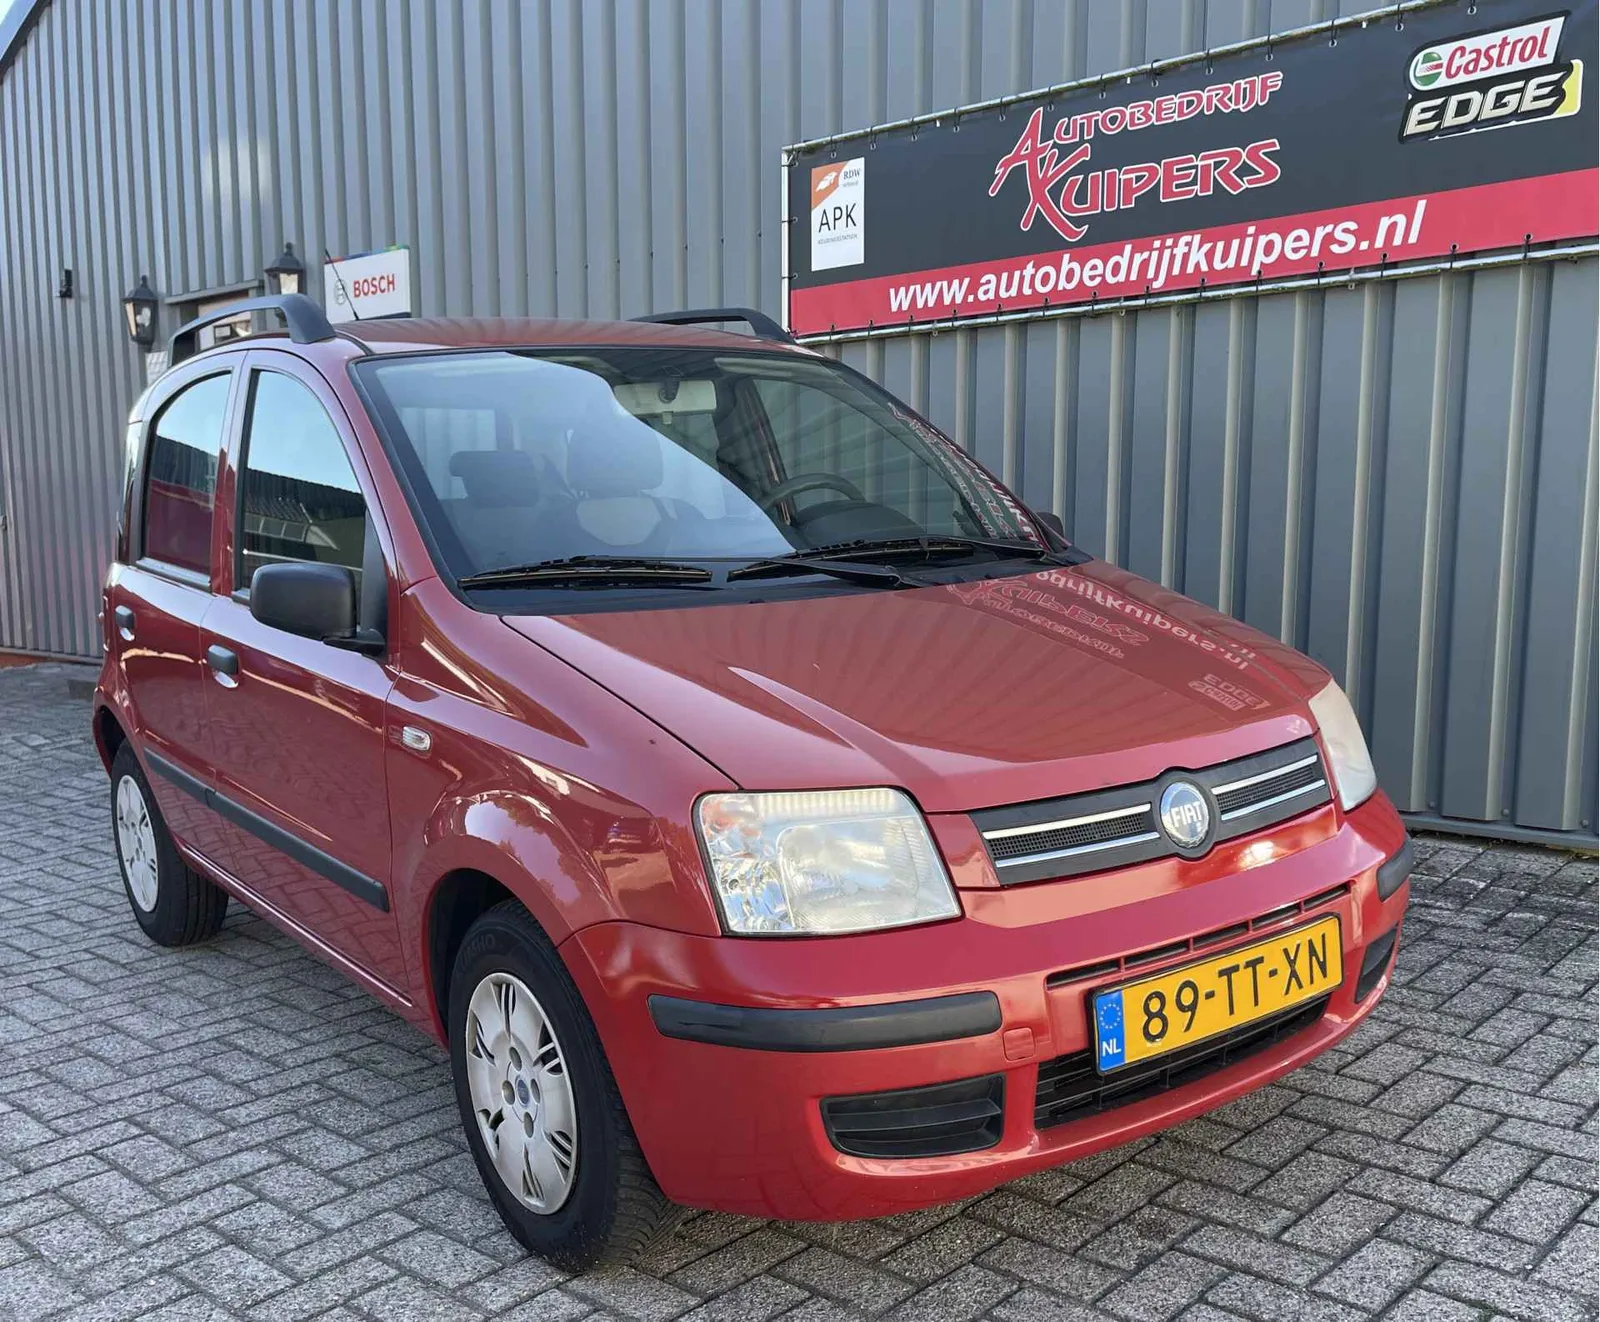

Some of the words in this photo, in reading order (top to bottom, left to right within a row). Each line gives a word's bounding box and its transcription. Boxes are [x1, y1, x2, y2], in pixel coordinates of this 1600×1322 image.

[1445, 26, 1551, 80] Castrol
[1403, 71, 1568, 137] EDGE
[988, 71, 1284, 197] AUTOBEDRIJF
[843, 168, 861, 180] RDW
[1020, 139, 1281, 242] KUIPERS
[818, 202, 857, 233] APK
[888, 199, 1428, 313] www.autobedrijfkuipers.nl
[353, 273, 396, 298] BOSCH
[1171, 801, 1202, 829] FIAT
[1142, 932, 1328, 1043] 89-TT-XN
[1102, 1038, 1121, 1057] NL
